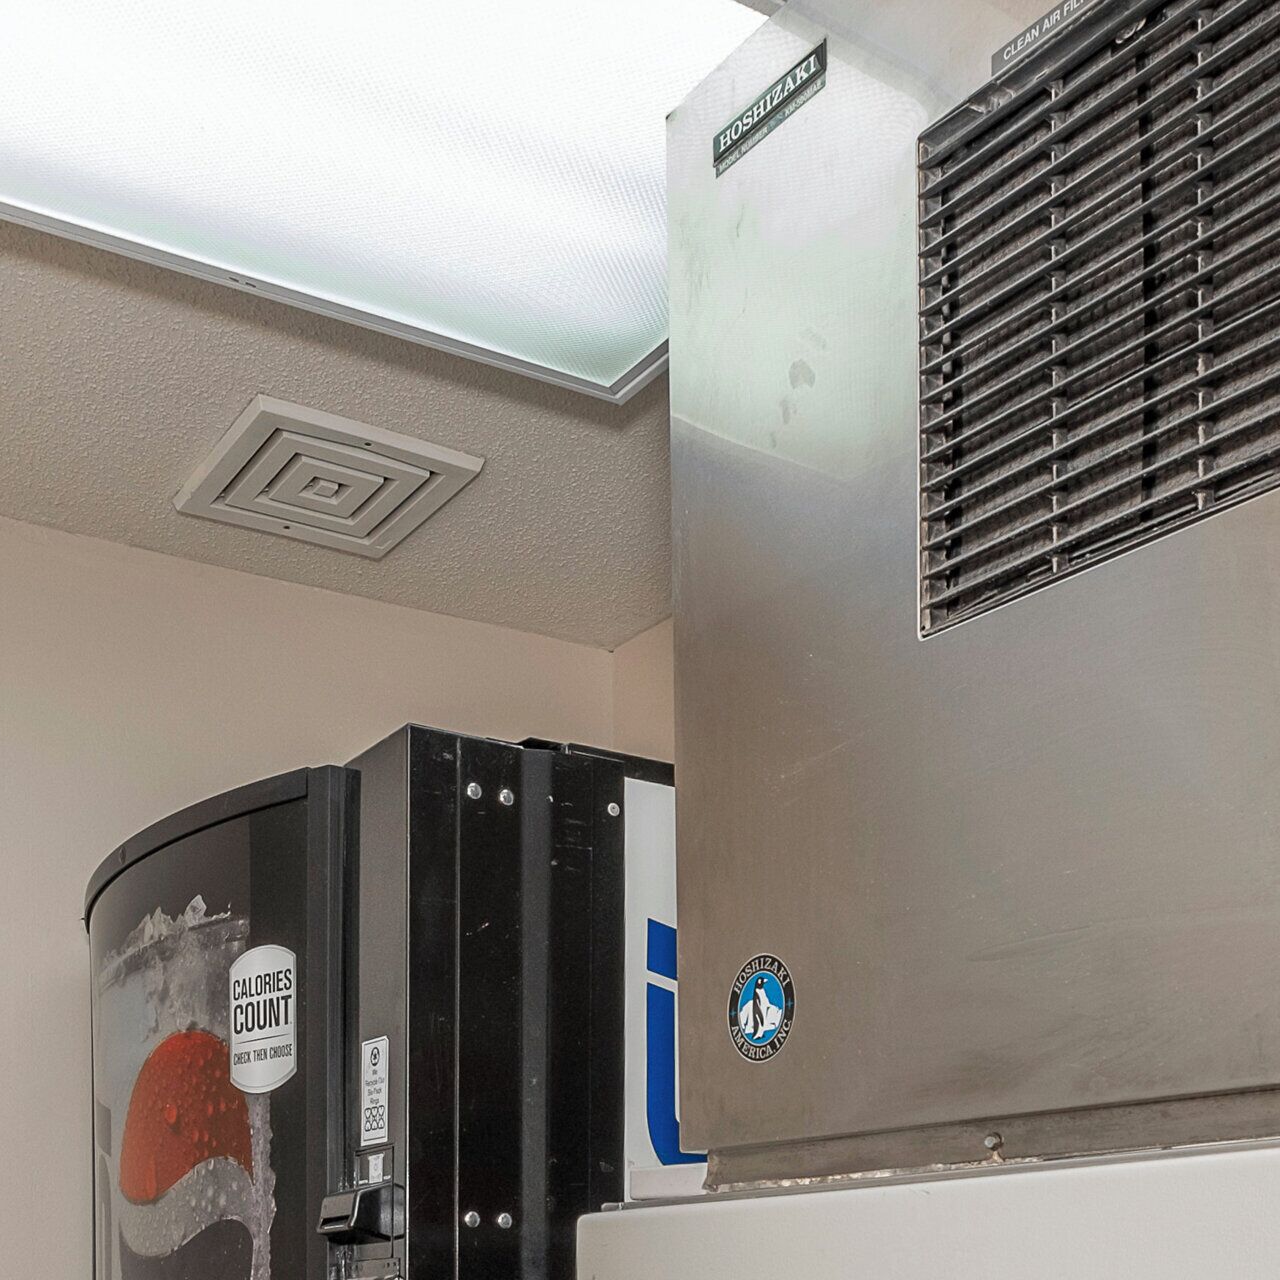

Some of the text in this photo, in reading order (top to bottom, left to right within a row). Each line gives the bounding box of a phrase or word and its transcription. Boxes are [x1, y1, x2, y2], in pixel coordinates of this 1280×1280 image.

[1003, 0, 1084, 60] CLEAN AIR FIL
[720, 54, 817, 152] HOSHIZAKI
[233, 968, 292, 1001] CALORIES
[734, 957, 790, 994] HOSHIZAKI
[233, 994, 292, 1035] COUNT
[233, 1043, 292, 1066] CHECK THEN CHOOSE
